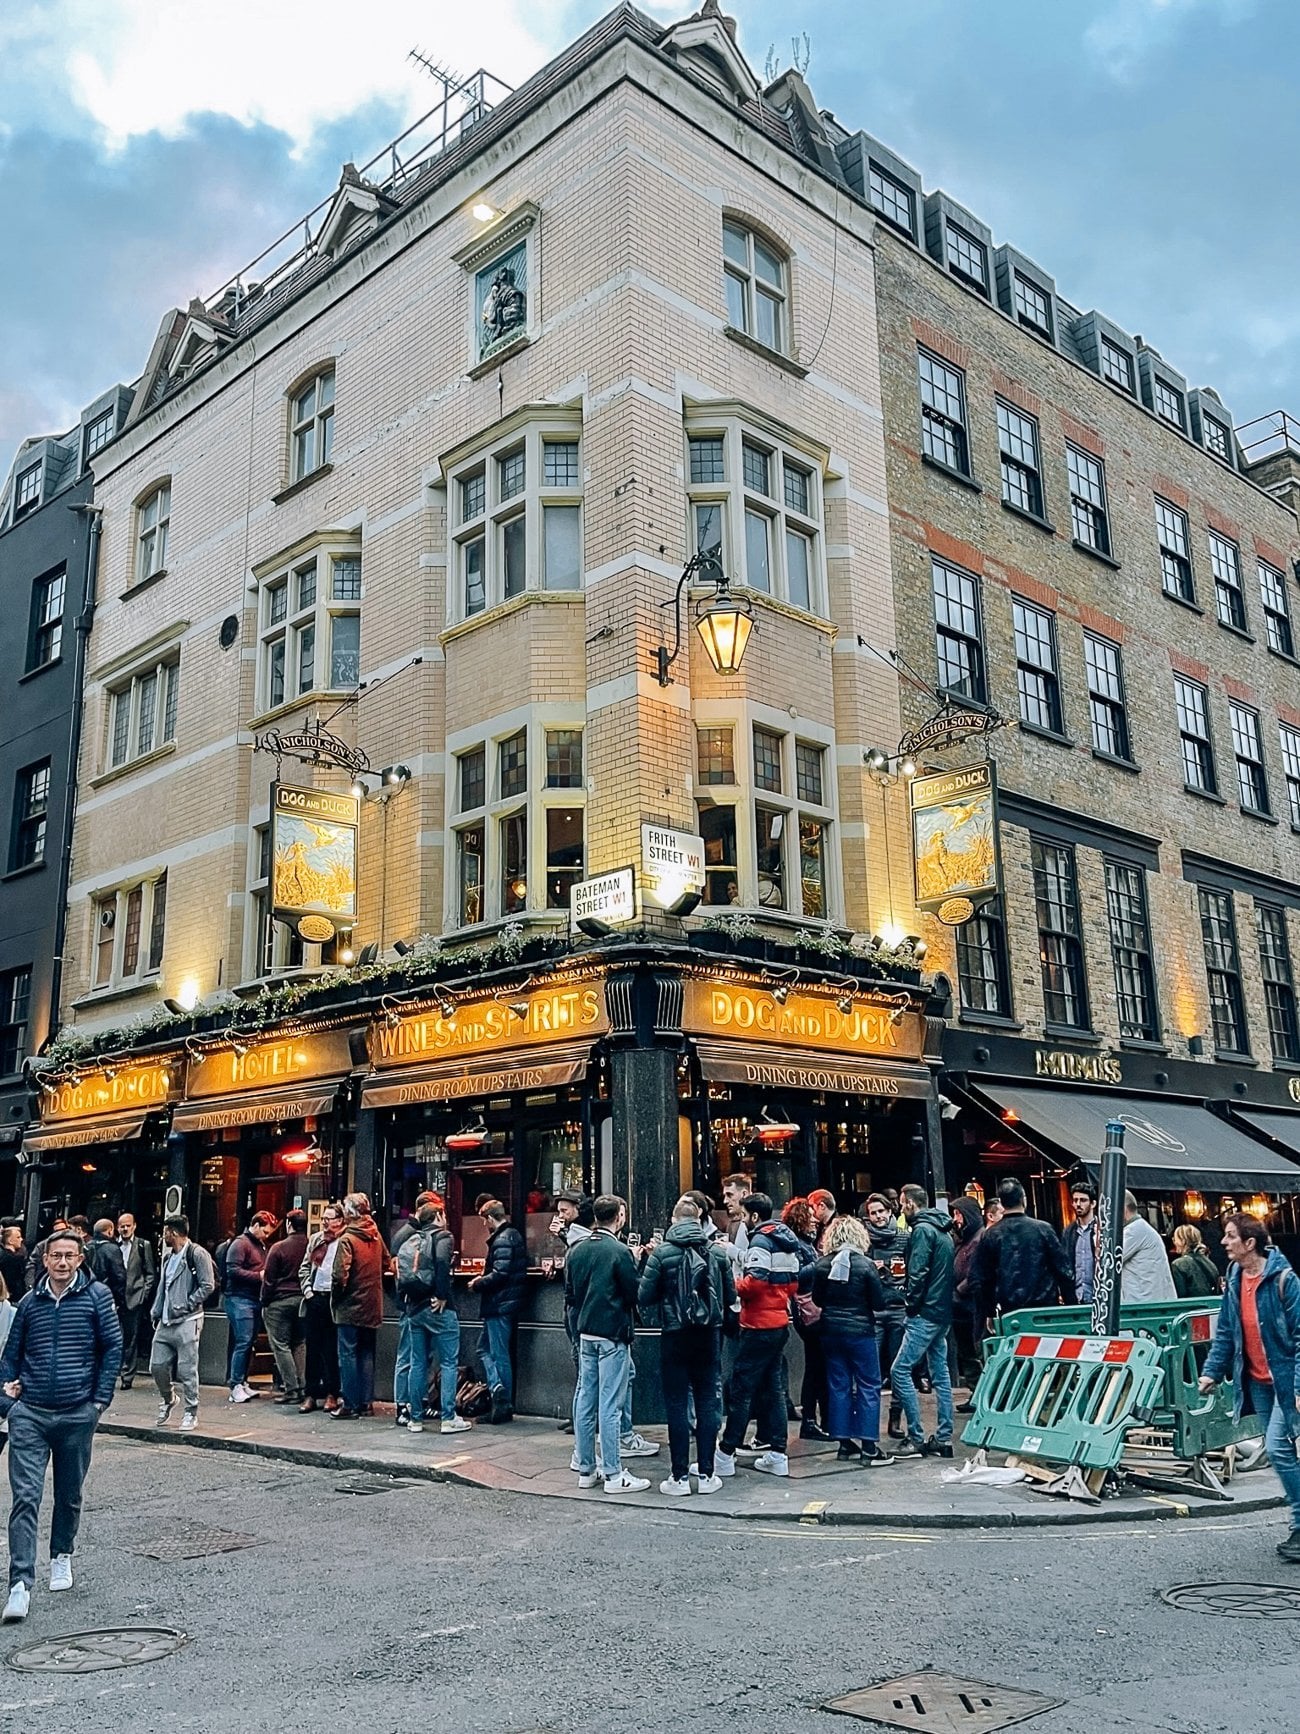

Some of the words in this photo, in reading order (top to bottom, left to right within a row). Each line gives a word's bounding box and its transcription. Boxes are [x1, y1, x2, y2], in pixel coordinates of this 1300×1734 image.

[912, 716, 983, 747] NICHOLSON'S
[281, 736, 356, 764] NICHOLSON'S
[918, 782, 940, 799] DOG
[941, 782, 955, 793] AND
[955, 770, 985, 789] DUCK
[281, 791, 305, 806] DOG
[306, 799, 319, 810] AND
[321, 798, 352, 815] DUCK
[649, 831, 676, 847] FRITH
[649, 846, 683, 864] STREET
[687, 854, 700, 868] W1
[576, 877, 620, 901] BATEMAN
[576, 896, 608, 916] STREET
[613, 891, 625, 905] W1
[380, 1018, 450, 1058] WINES
[452, 1023, 485, 1046] AND
[486, 990, 599, 1040] SPIRITS
[711, 991, 776, 1032] DOG
[780, 1009, 821, 1037] AND
[824, 1007, 897, 1047] DUCK
[232, 1045, 299, 1082] HOTEL
[49, 1086, 83, 1114] DOG
[112, 1069, 168, 1103] DUCK
[400, 1082, 441, 1102] DINING
[443, 1078, 479, 1096] ROOM
[482, 1070, 543, 1092] UPSTAIRS
[746, 1065, 797, 1085] DINING
[799, 1071, 839, 1089] ROOM
[842, 1076, 898, 1094] UPSTAIRS
[200, 1111, 229, 1128] DINING
[231, 1107, 256, 1123] ROOM
[259, 1102, 302, 1120] UPSTAIRS
